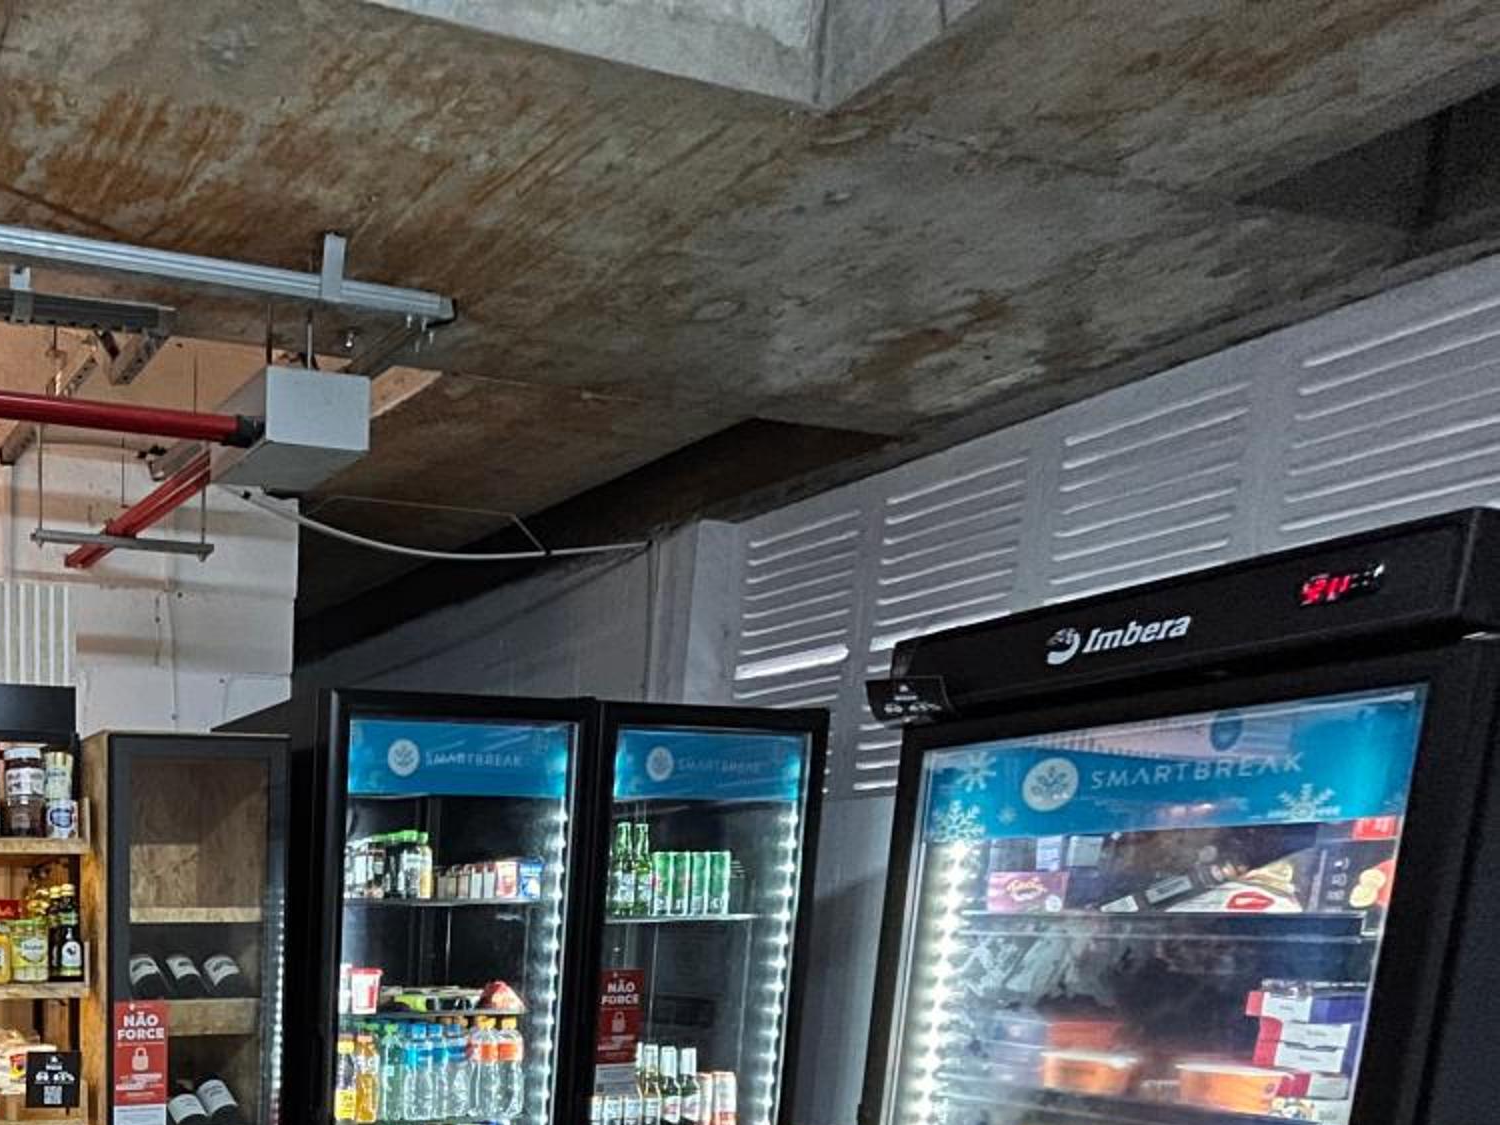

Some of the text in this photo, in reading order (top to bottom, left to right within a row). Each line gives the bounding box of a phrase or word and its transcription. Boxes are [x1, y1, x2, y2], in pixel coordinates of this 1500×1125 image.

[1081, 614, 1192, 655] Imbera
[1091, 752, 1303, 789] SMARTBREAK
[607, 978, 636, 993] NÃO
[600, 994, 639, 1005] FORCE
[123, 1011, 159, 1028] NÃO
[117, 1028, 165, 1041] FORCE
